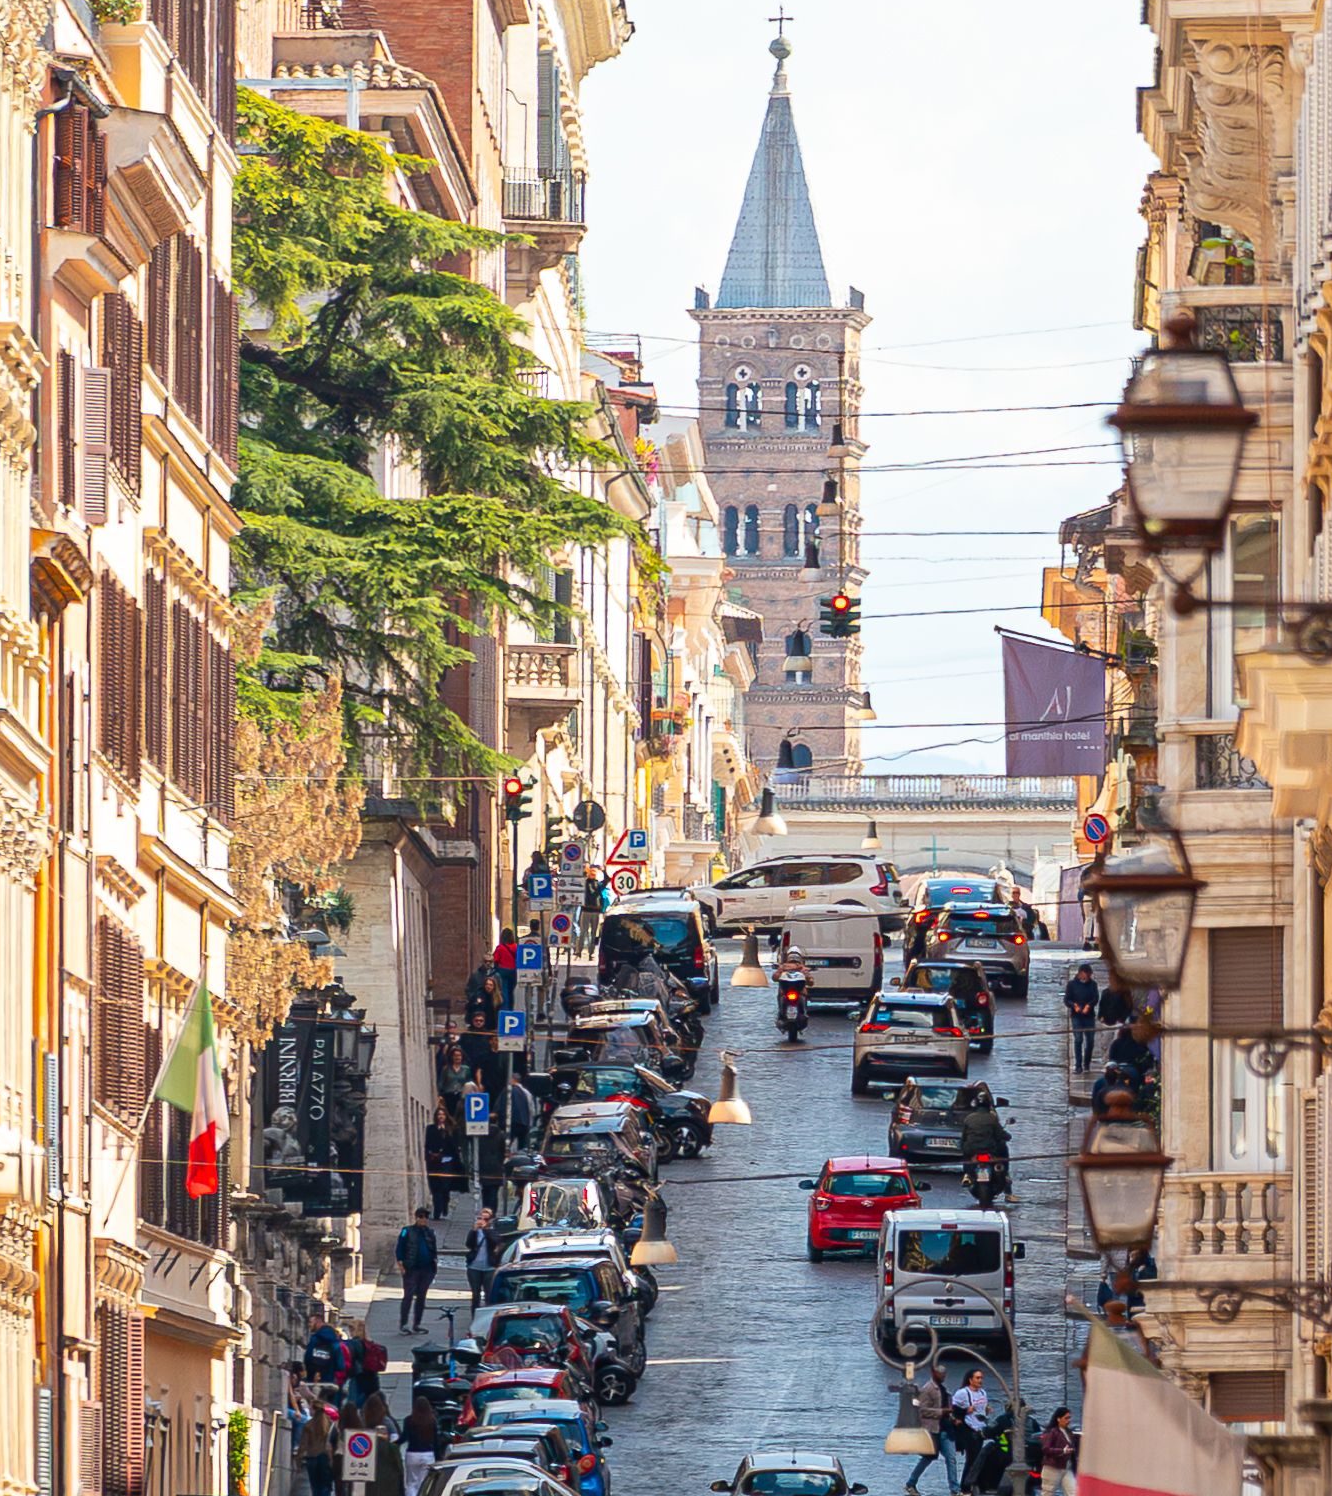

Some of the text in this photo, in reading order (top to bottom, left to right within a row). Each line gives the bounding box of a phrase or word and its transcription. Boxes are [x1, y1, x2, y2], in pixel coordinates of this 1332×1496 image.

[1065, 730, 1091, 741] hotel
[633, 833, 644, 846] P
[533, 877, 547, 896] P
[617, 876, 634, 890] 30
[522, 948, 536, 965] P
[504, 1015, 519, 1034] P
[278, 1038, 298, 1104] BERNINI
[470, 1096, 484, 1120] P
